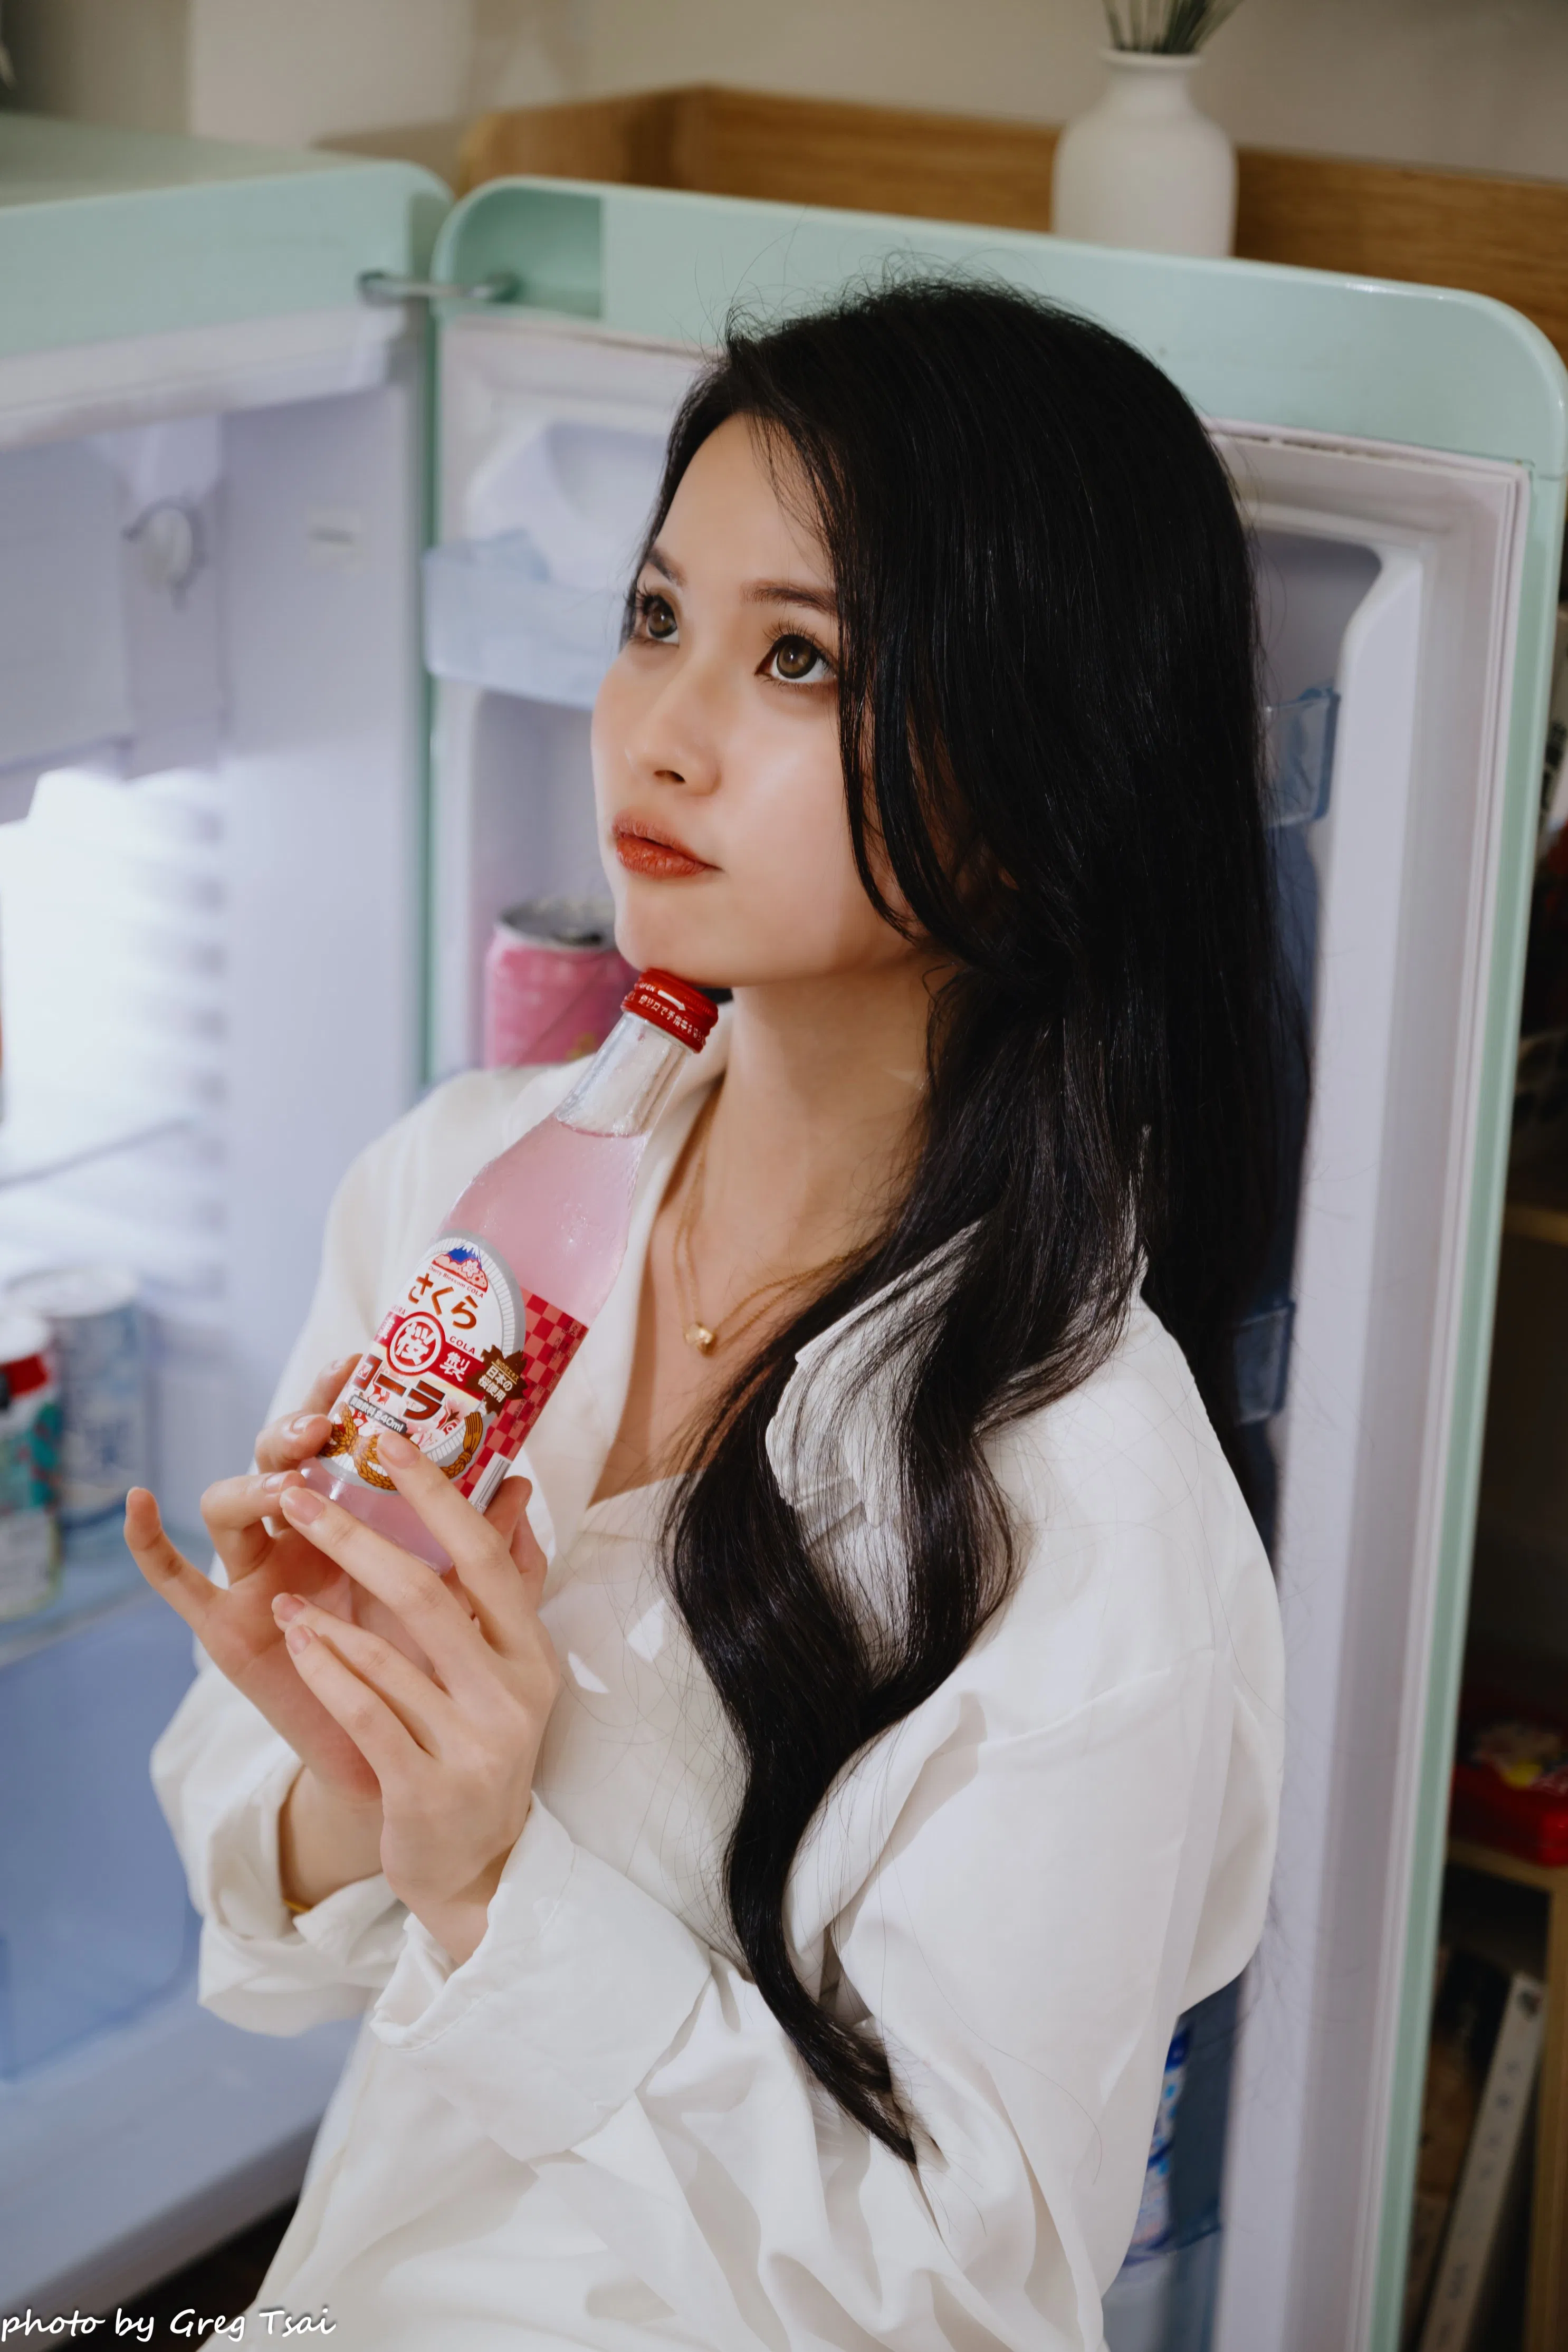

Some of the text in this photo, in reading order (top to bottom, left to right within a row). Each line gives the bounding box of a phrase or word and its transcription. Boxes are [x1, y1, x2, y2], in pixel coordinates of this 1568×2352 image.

[639, 982, 656, 992] OPEN
[428, 1265, 483, 1298] Cherry Blossom COLA
[408, 1273, 478, 1330] さくら
[450, 1335, 475, 1355] COLA
[439, 1351, 470, 1382] 製
[486, 1365, 513, 1391] 日本の
[352, 1353, 446, 1421] コーラ
[477, 1374, 506, 1403] 桜使用
[374, 1408, 404, 1432] 240ml
